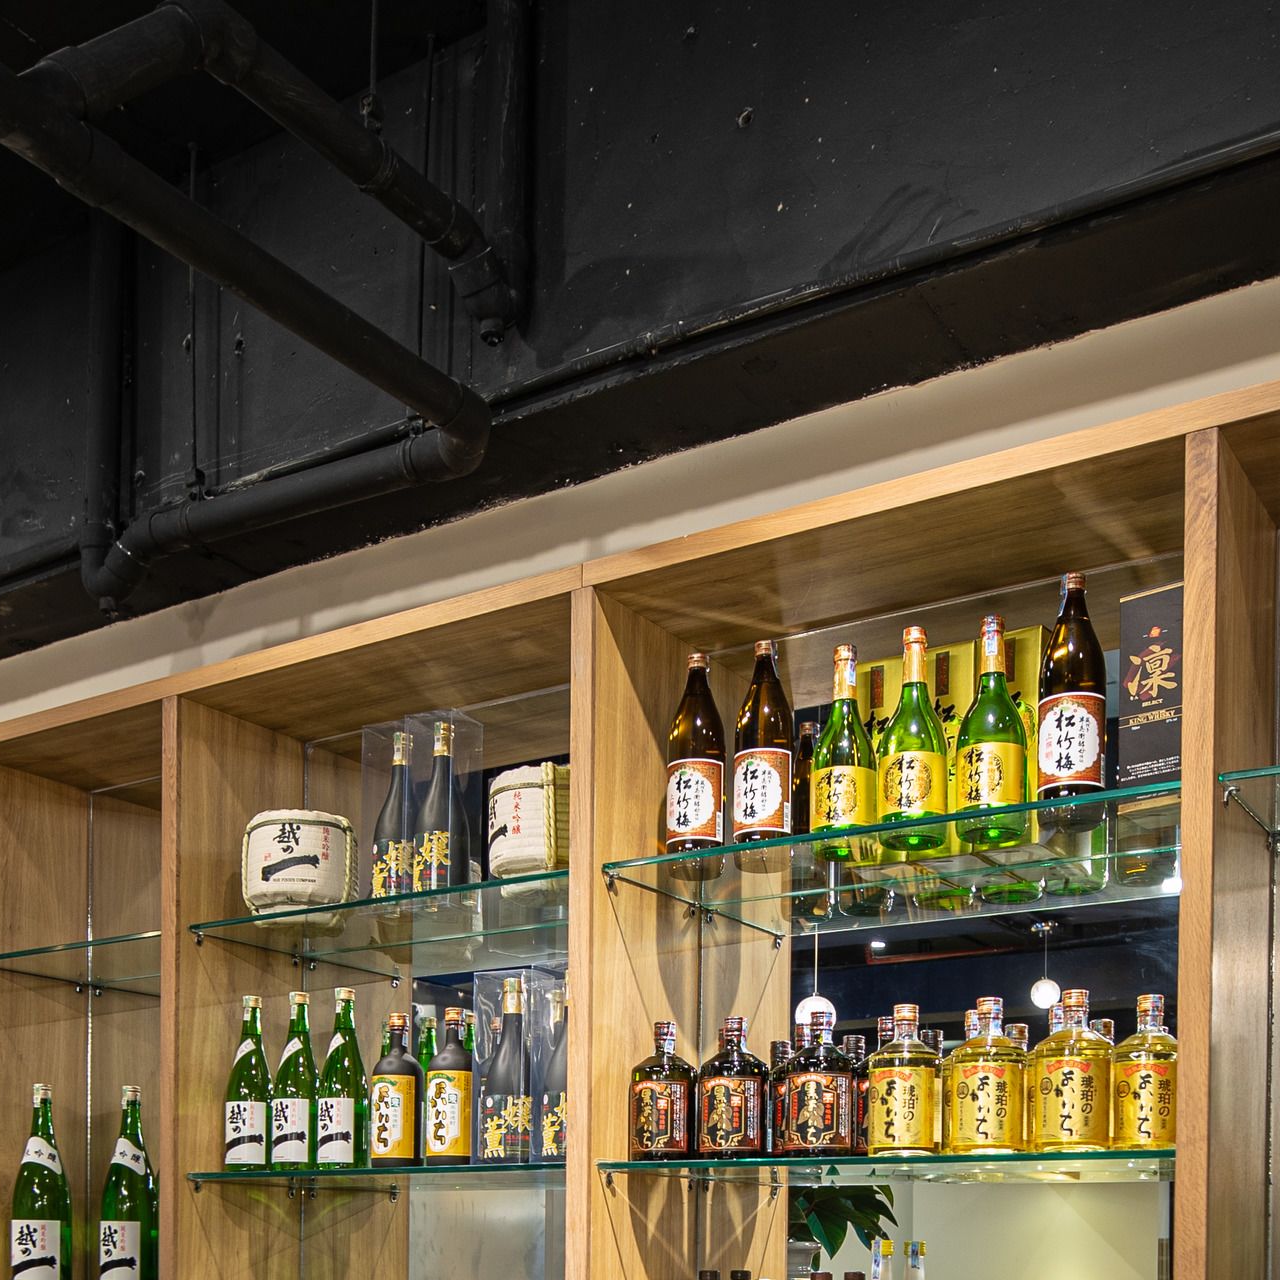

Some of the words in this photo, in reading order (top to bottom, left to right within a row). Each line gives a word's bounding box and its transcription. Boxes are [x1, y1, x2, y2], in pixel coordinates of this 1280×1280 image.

[1055, 709, 1076, 772] 松竹梅
[1128, 714, 1150, 726] KING
[676, 773, 692, 828] 松竹梅
[742, 763, 759, 821] 松竹梅
[821, 769, 846, 824] 松竹梅
[892, 754, 915, 811] 松竹梅
[963, 747, 986, 802] 松竹梅
[880, 1079, 897, 1142] よかいち
[902, 1084, 915, 1121] 琥珀の
[970, 1076, 991, 1139] よかいち
[995, 1080, 1008, 1119] 琥珀の
[1053, 1070, 1075, 1136] よかいち
[1080, 1075, 1094, 1115] 琥珀の
[1131, 1073, 1153, 1138] よかいち
[1158, 1078, 1170, 1117] 琥珀の
